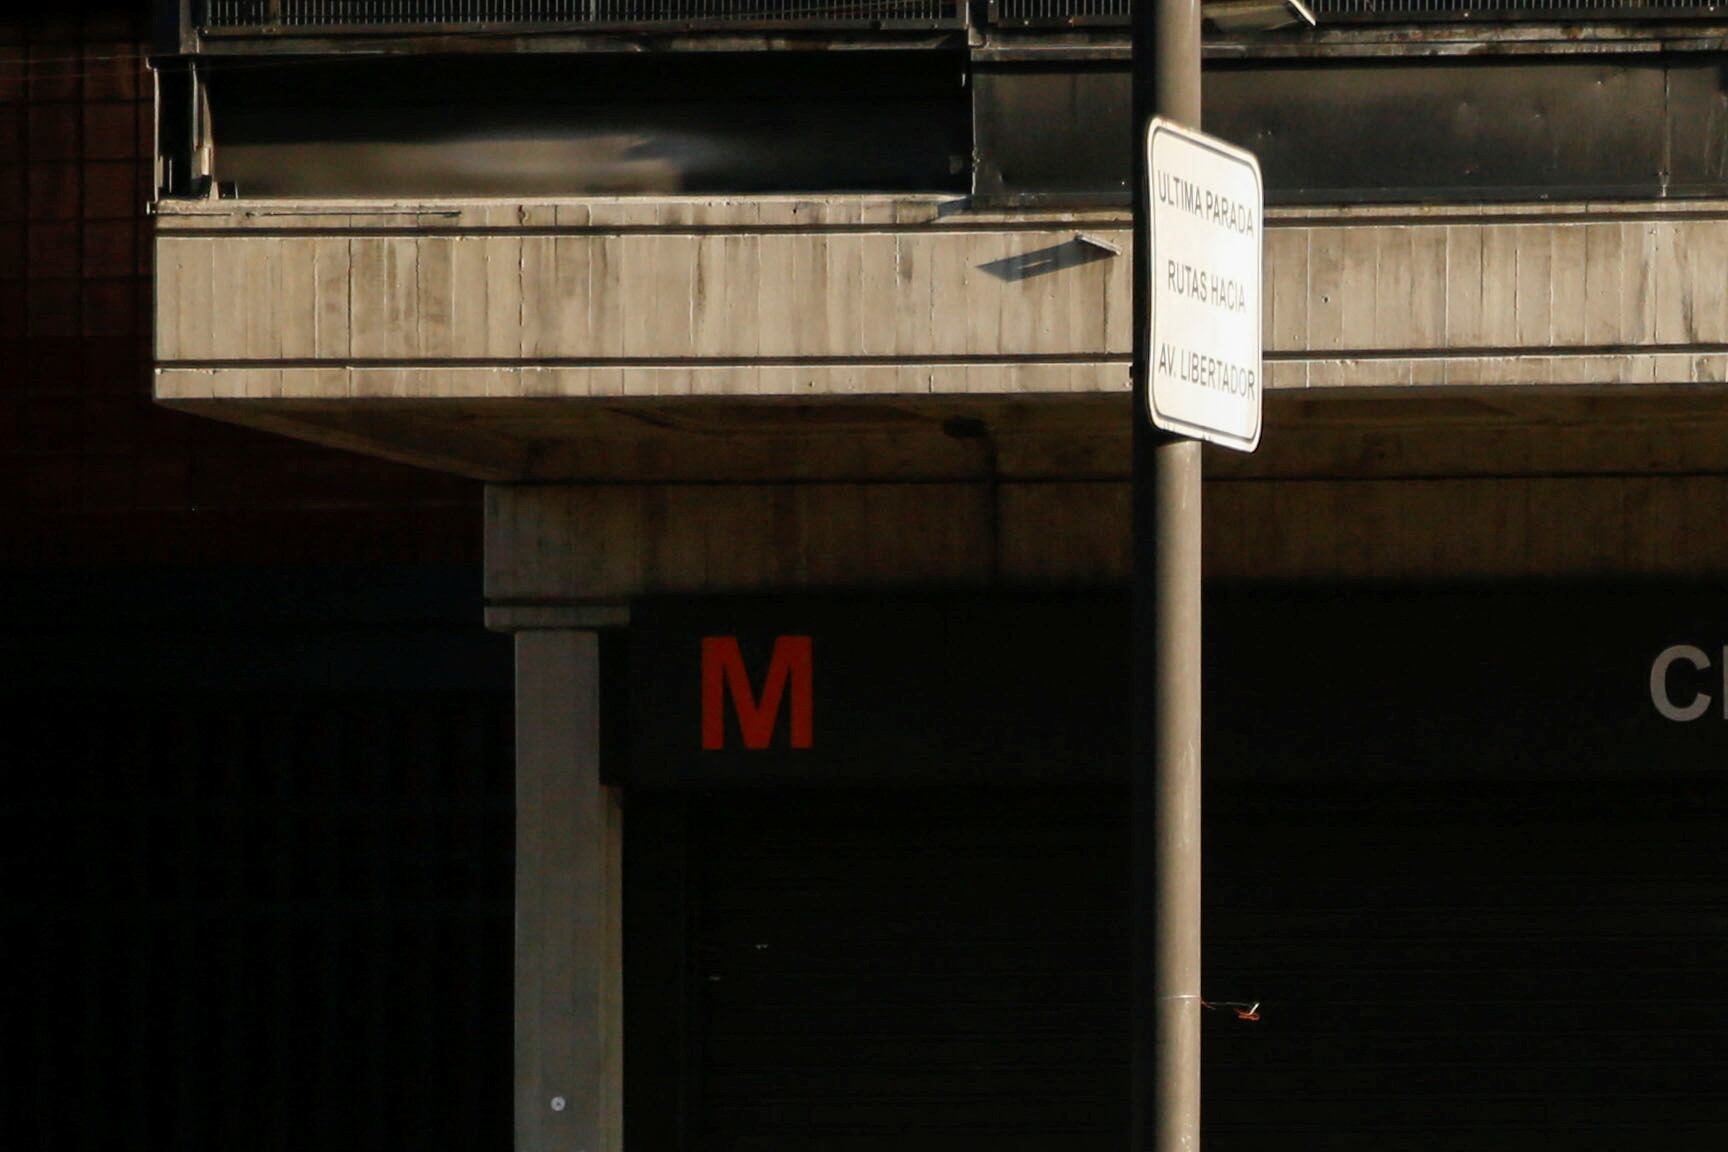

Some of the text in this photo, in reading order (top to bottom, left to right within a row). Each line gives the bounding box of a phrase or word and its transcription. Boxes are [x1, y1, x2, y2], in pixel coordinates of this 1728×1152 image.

[1158, 169, 1254, 238] ULTIMA PARADA
[1168, 259, 1247, 313] RUTAS HACIA
[1159, 342, 1255, 401] AV. LIBERTADOR
[702, 635, 812, 750] M
